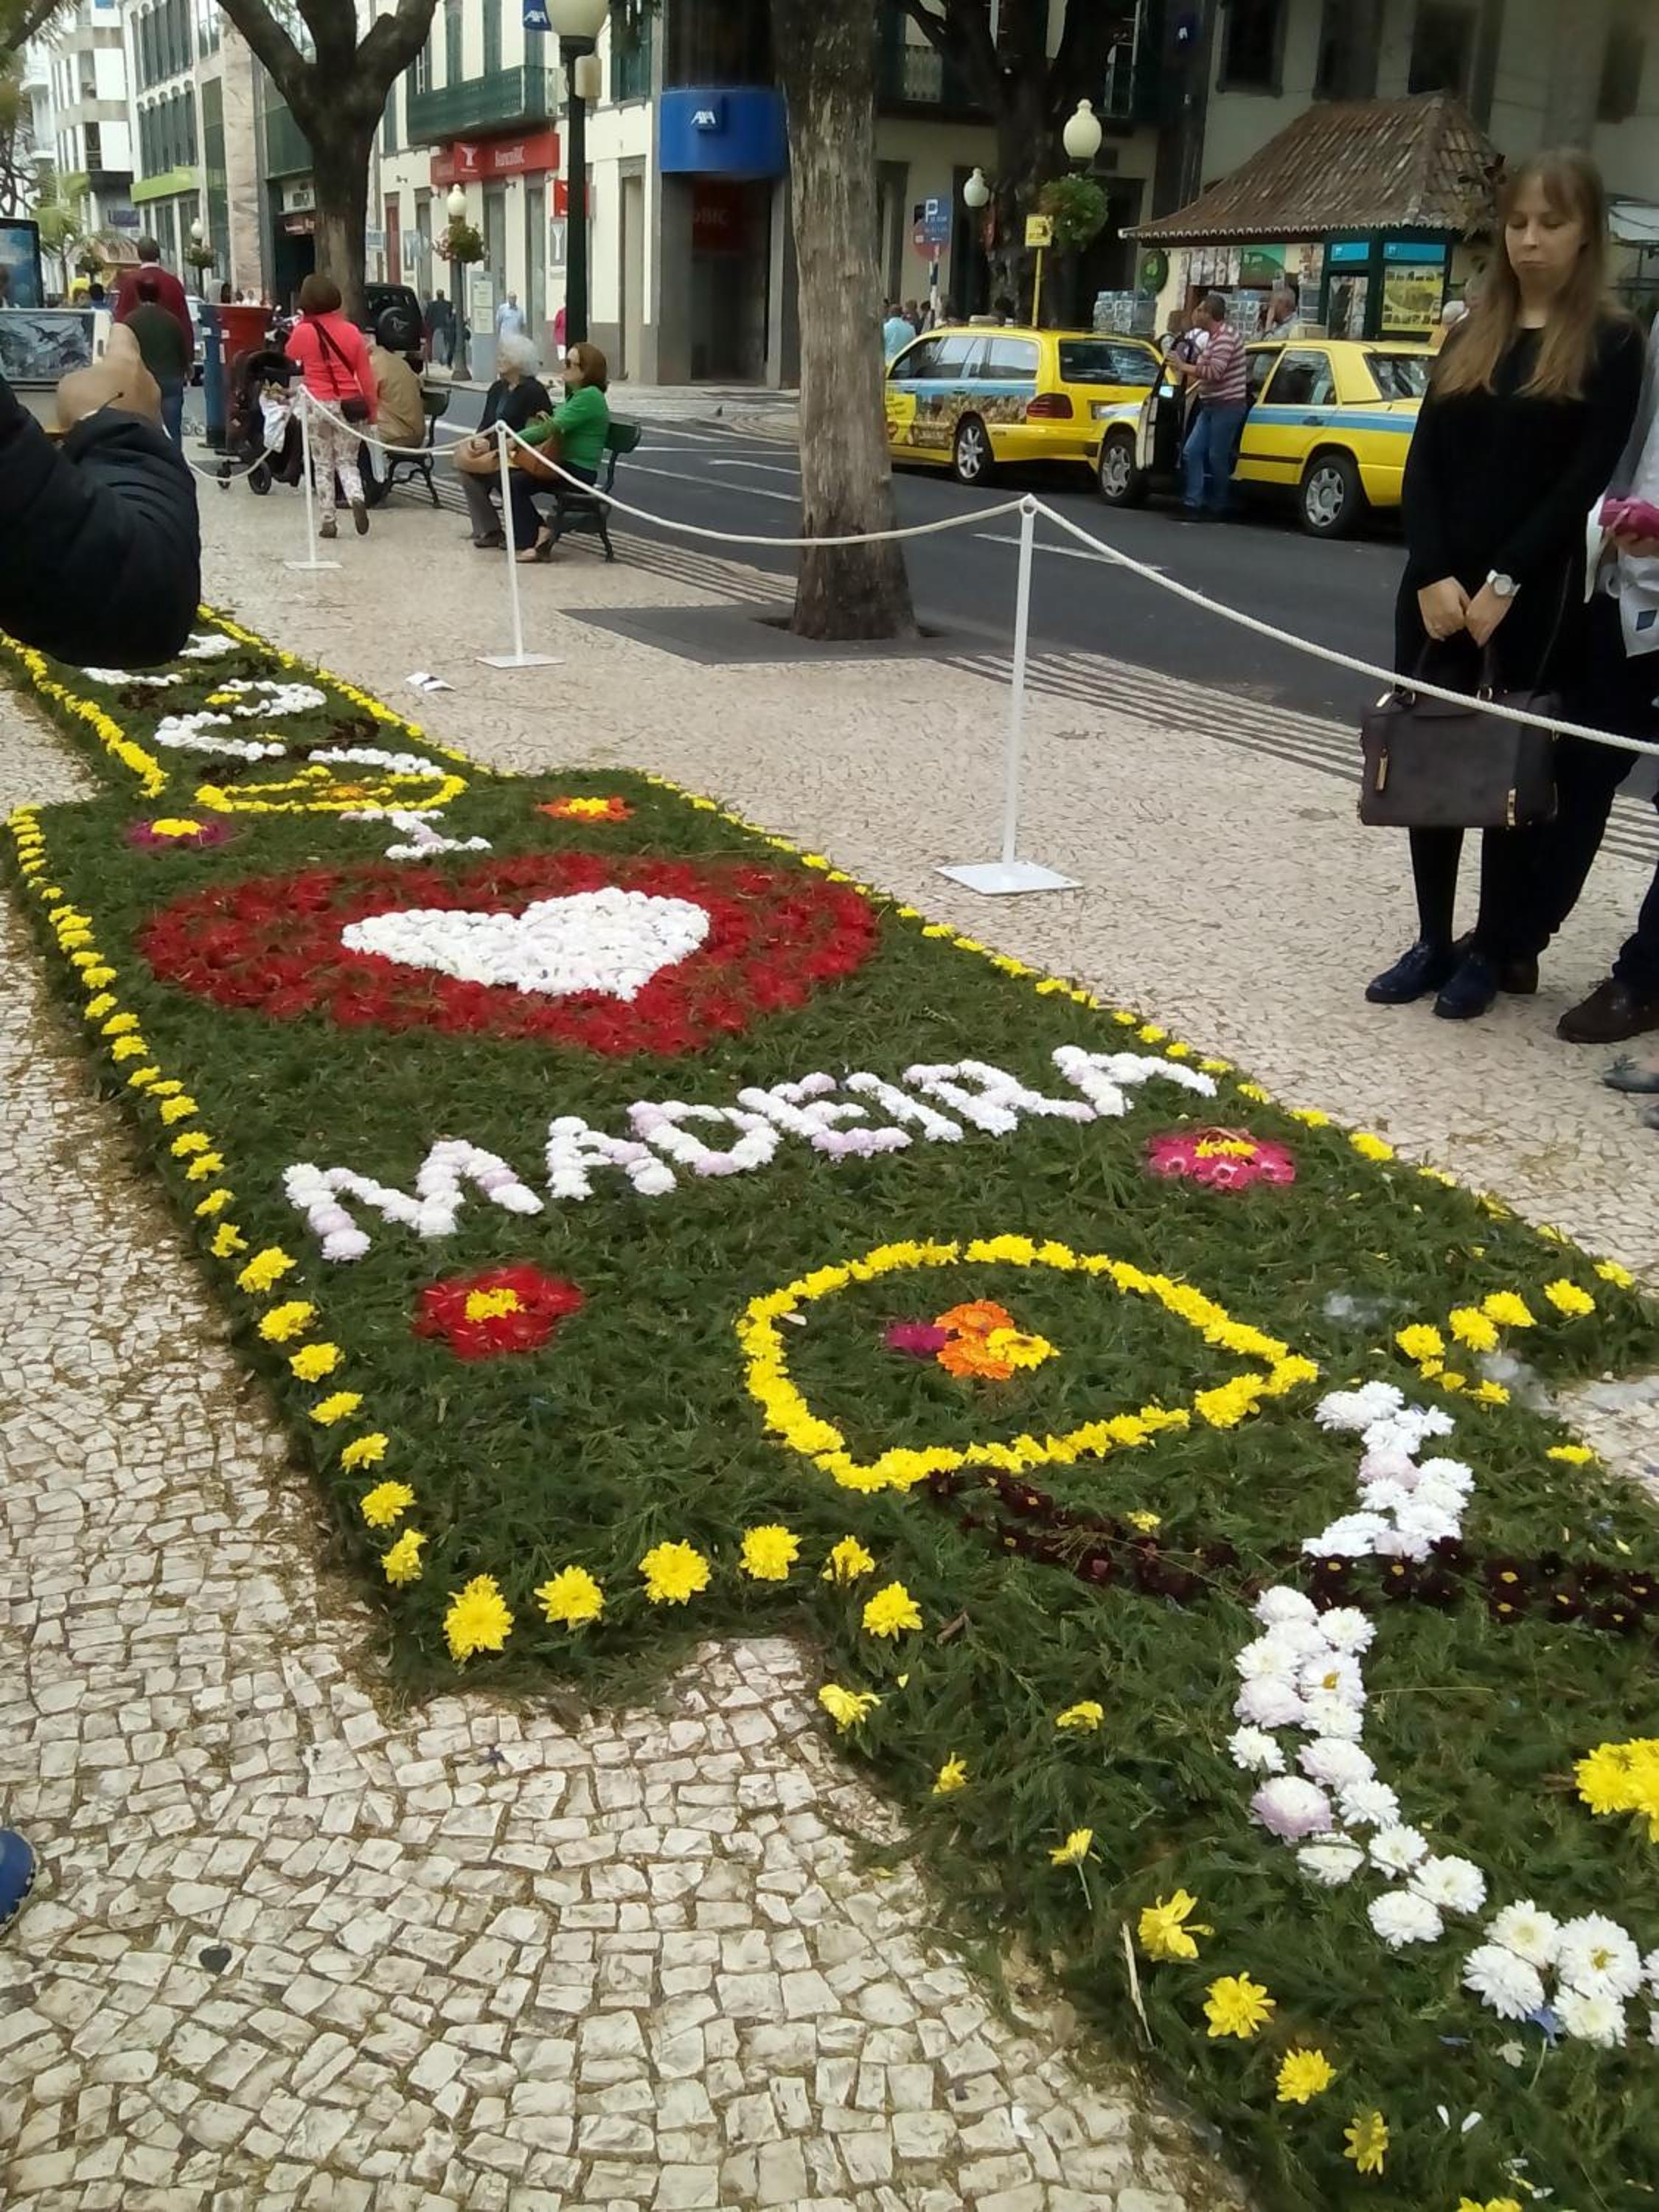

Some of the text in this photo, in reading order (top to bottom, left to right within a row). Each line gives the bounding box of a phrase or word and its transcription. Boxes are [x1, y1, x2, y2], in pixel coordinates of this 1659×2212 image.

[524, 10, 548, 24] AXA
[690, 110, 717, 125] AXA
[925, 198, 939, 223] P
[283, 1044, 1217, 1262] MADEIRA
